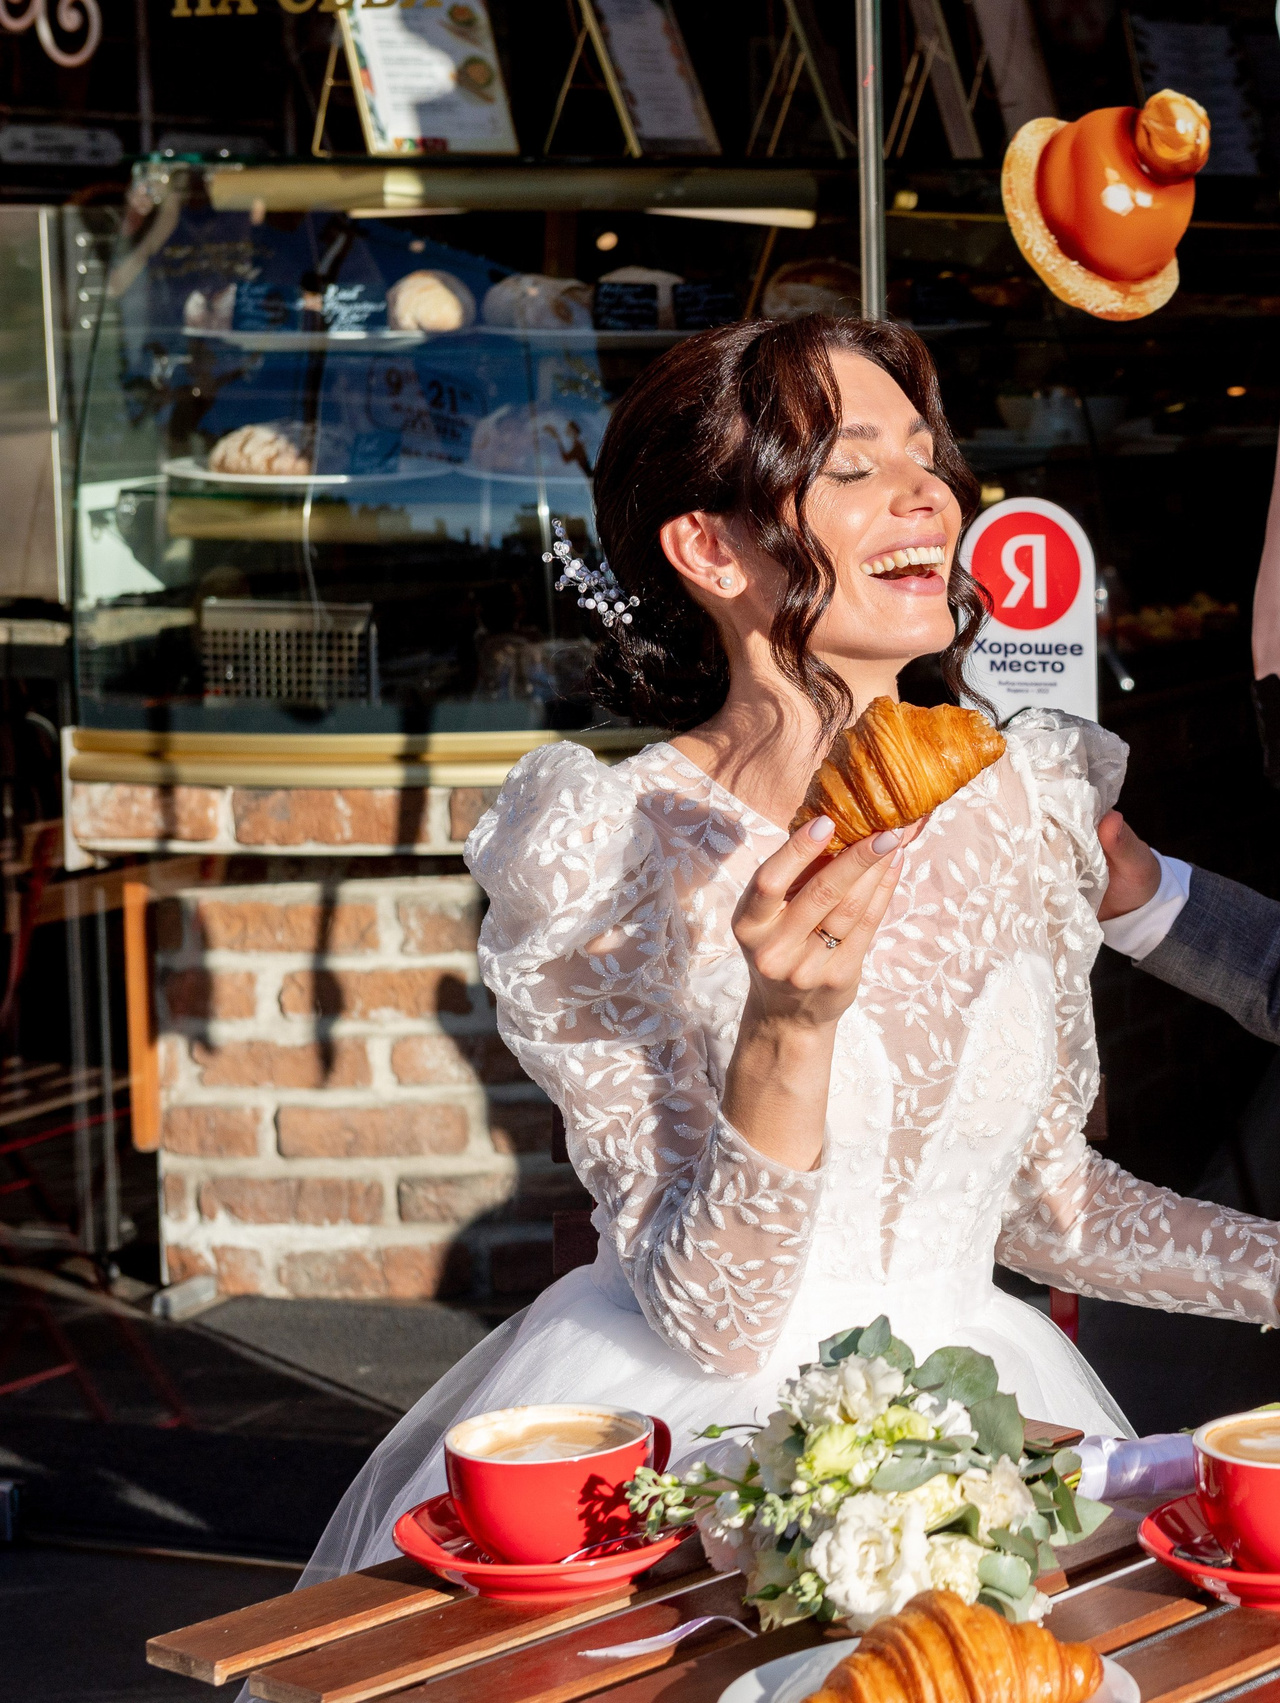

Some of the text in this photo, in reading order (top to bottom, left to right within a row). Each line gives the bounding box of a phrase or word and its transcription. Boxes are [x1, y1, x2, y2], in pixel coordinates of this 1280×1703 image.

[1001, 534, 1047, 609] Я
[973, 638, 1084, 658] Хорошее
[990, 659, 1065, 674] место
